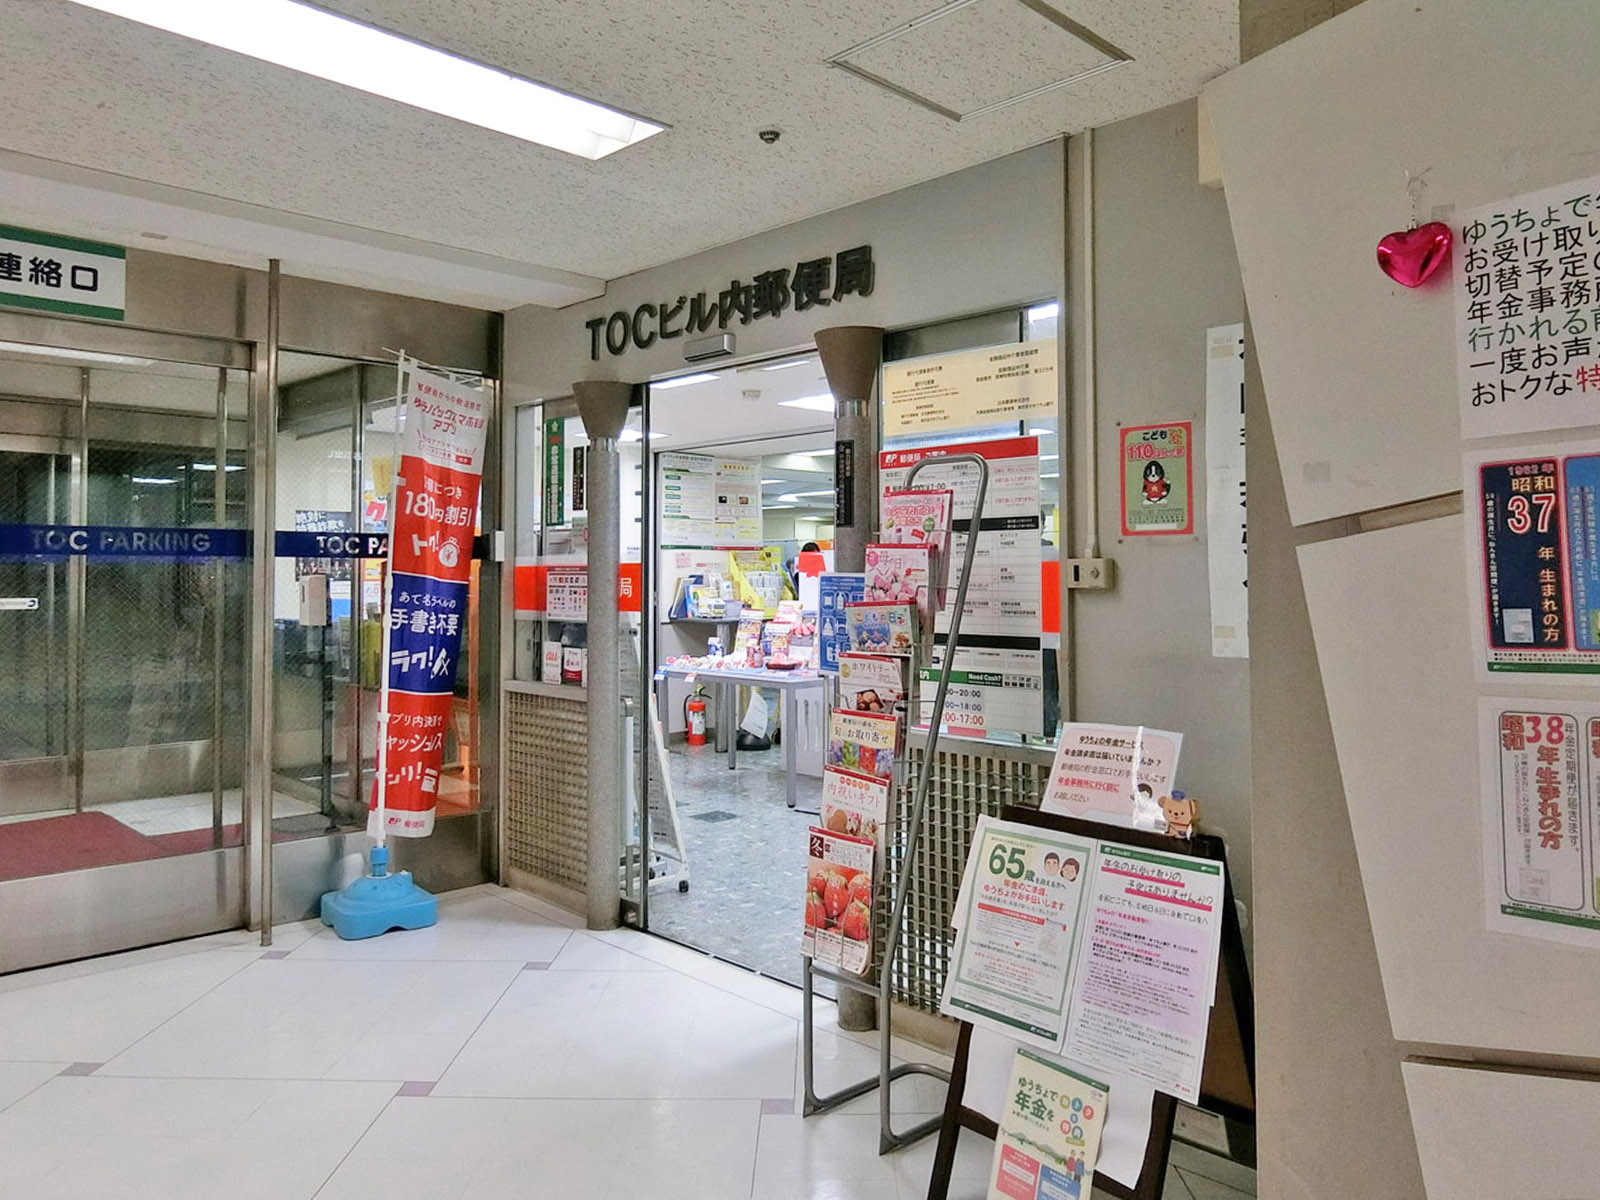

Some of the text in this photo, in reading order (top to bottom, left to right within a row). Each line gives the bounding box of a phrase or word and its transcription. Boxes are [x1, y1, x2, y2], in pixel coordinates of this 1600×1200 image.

[1463, 194, 1600, 245] ゆうちょで
[585, 245, 876, 361] TOCビル内郵便局
[1467, 277, 1600, 324] 年金事務
[1470, 337, 1600, 374] 一度お声
[1142, 430, 1167, 441] こども
[1511, 475, 1555, 493] 昭和
[1507, 493, 1556, 535] 37
[33, 529, 212, 552] TOC PARKING
[316, 535, 360, 554] TOC
[391, 608, 460, 636] 手書き不要
[1526, 715, 1564, 745] 38
[1063, 748, 1162, 767] 年金請求書は届いていまんか？
[1018, 1076, 1059, 1102] ゆうちょで
[1014, 1089, 1056, 1122] 年金を
